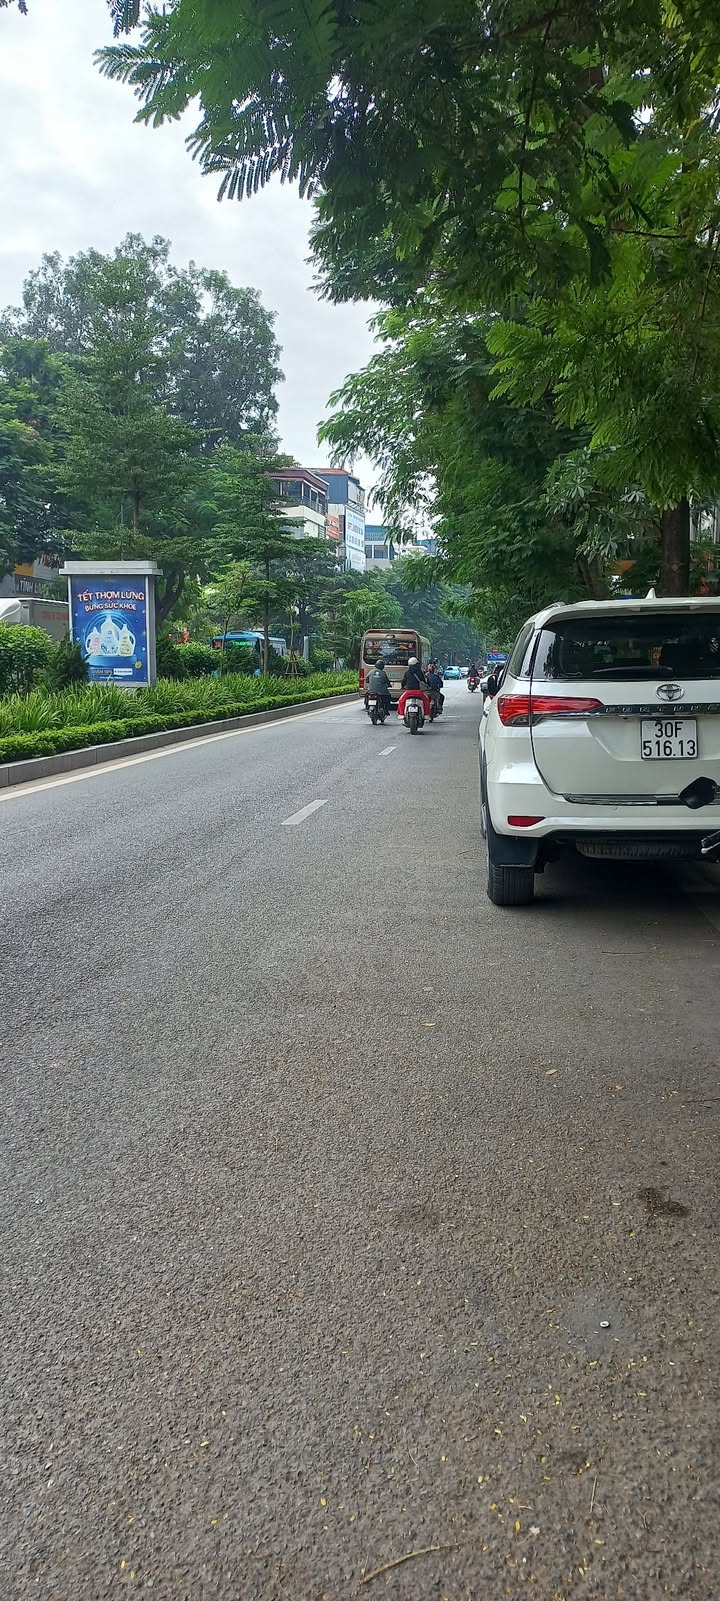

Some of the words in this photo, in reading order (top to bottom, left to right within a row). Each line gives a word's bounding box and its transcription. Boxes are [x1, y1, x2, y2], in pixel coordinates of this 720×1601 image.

[77, 589, 93, 602] TẾT
[95, 591, 120, 600] THƠM
[121, 588, 145, 600] LỪNG
[104, 600, 119, 609] SỨC
[654, 721, 684, 738] 30F
[642, 740, 696, 757] 516.13
